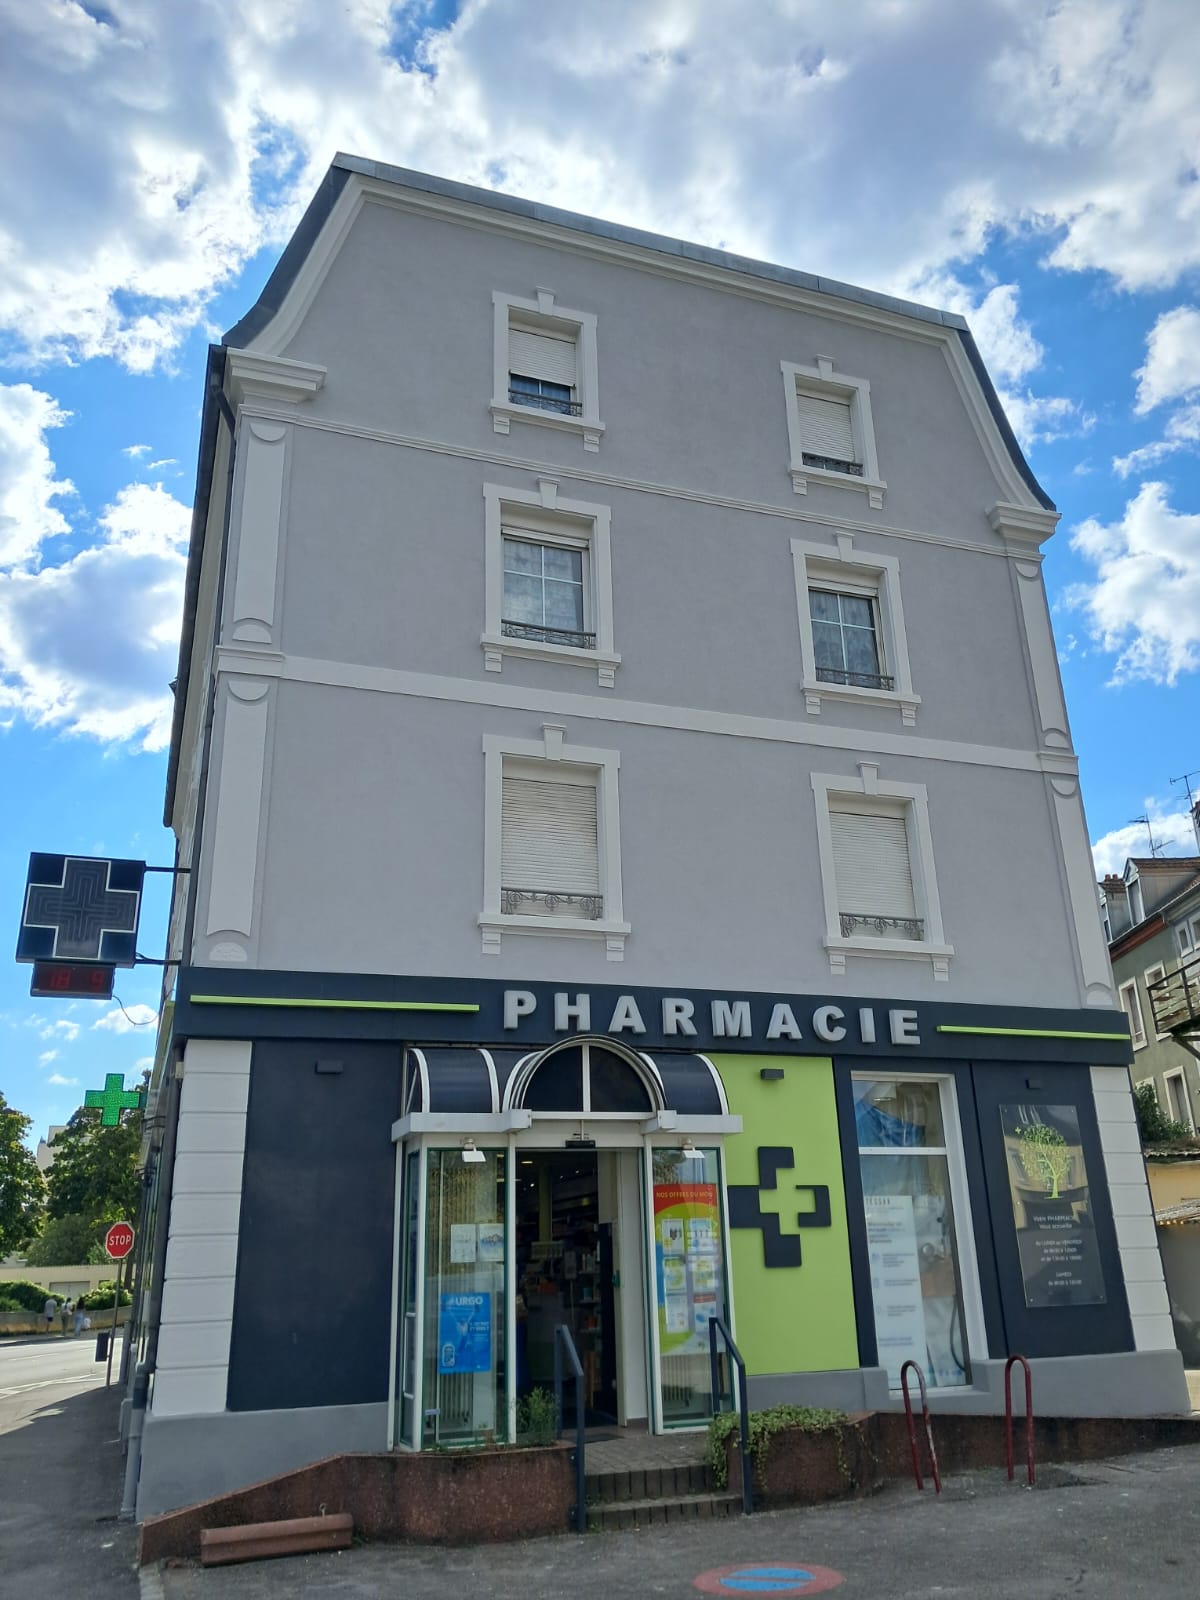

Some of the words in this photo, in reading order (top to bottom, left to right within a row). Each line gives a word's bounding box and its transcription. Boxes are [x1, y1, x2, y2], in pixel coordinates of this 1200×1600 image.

[503, 989, 922, 1046] PHARMACIE
[109, 1234, 132, 1246] STOP
[456, 1296, 483, 1305] URGO
